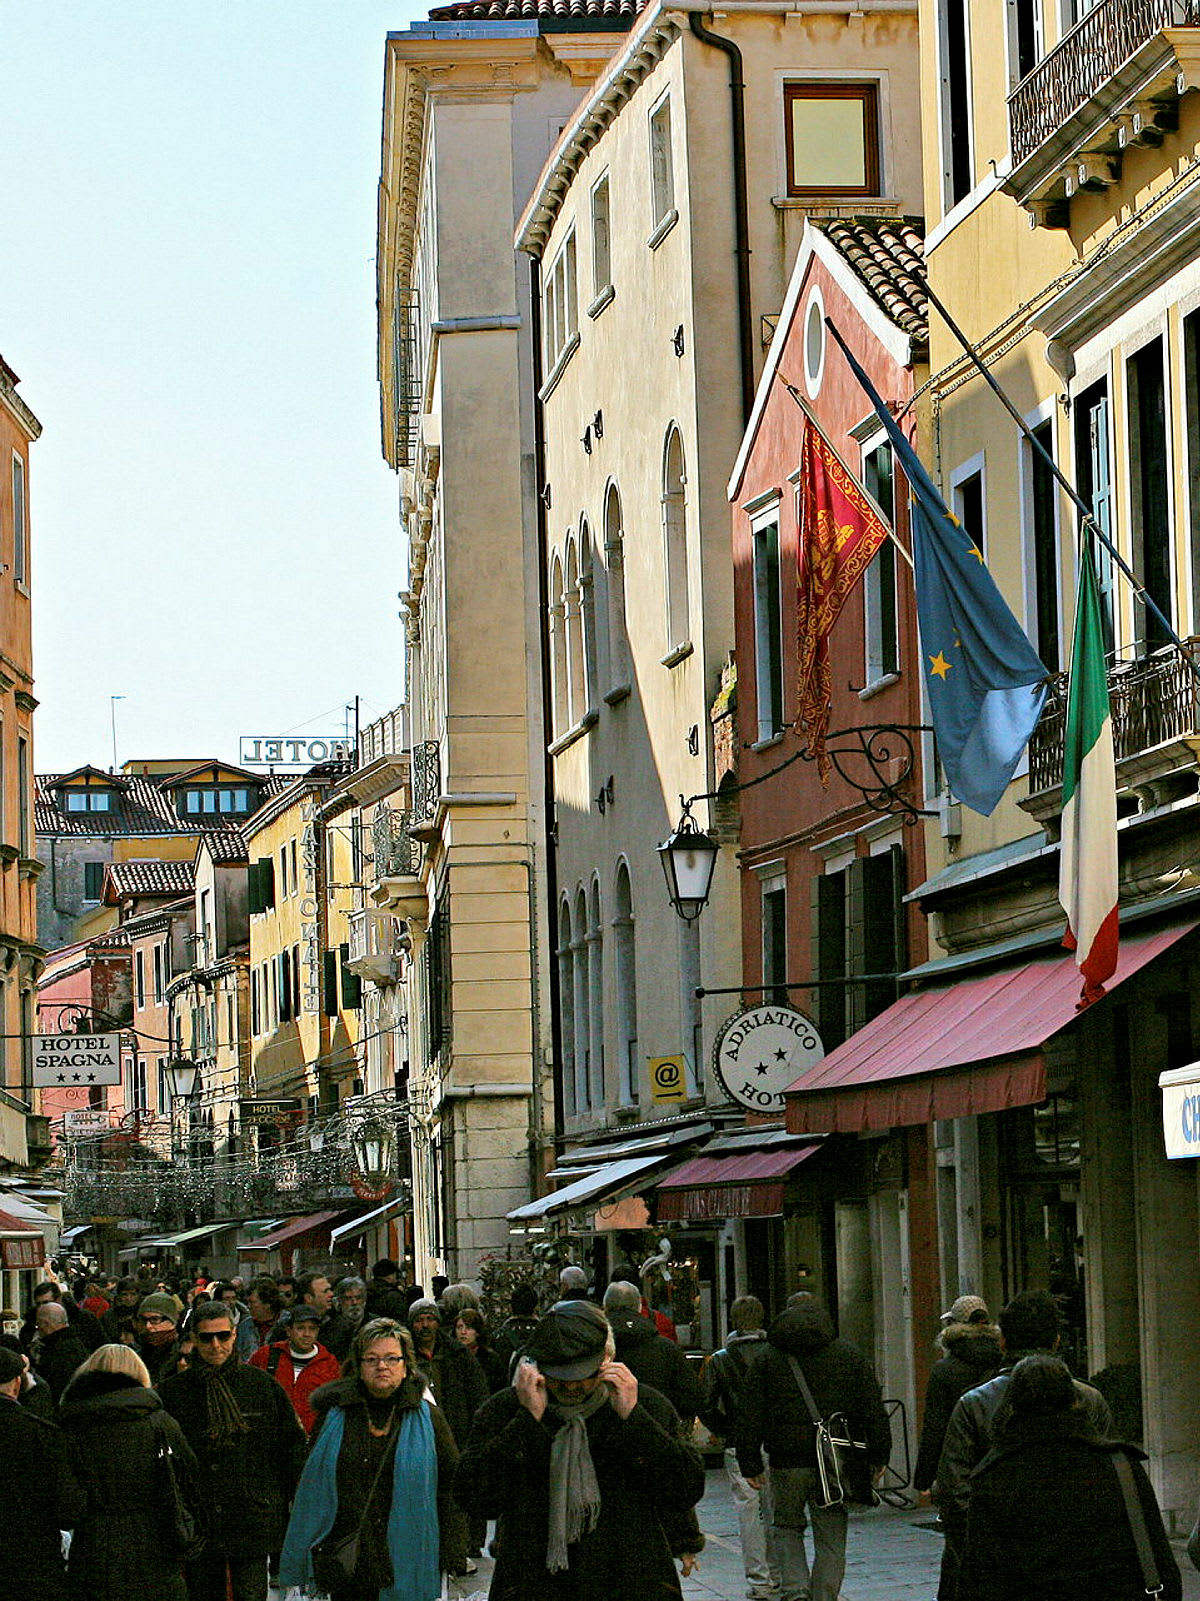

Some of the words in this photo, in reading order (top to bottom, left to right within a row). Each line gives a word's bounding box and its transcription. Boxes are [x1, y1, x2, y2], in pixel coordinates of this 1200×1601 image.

[725, 1011, 816, 1062] ADRIATICO
[41, 1037, 110, 1051] HOTEL
[36, 1053, 115, 1068] SPAGNA
[253, 1105, 280, 1113] HOTEL
